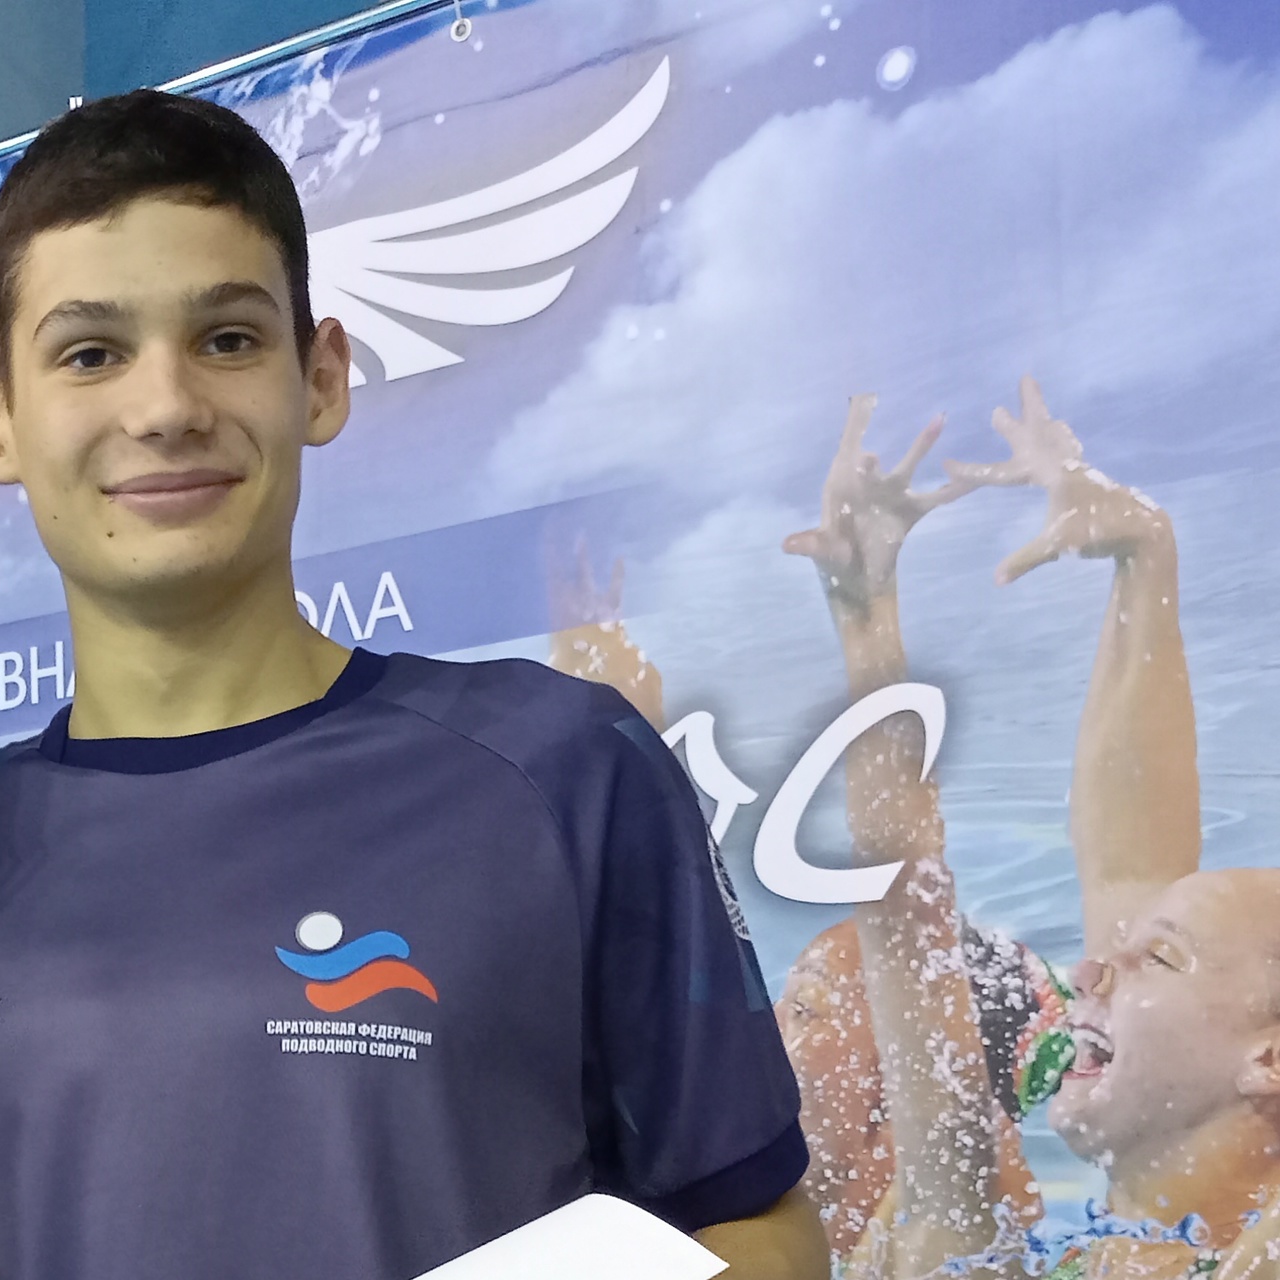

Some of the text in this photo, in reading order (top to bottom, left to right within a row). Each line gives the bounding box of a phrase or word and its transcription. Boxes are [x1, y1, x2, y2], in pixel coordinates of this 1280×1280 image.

[266, 1019, 433, 1046] САРАТОВСКАЯ ФЕДЕРАЦИЯ
[281, 1038, 417, 1061] ПОДВОДНОГО СПОРТА
